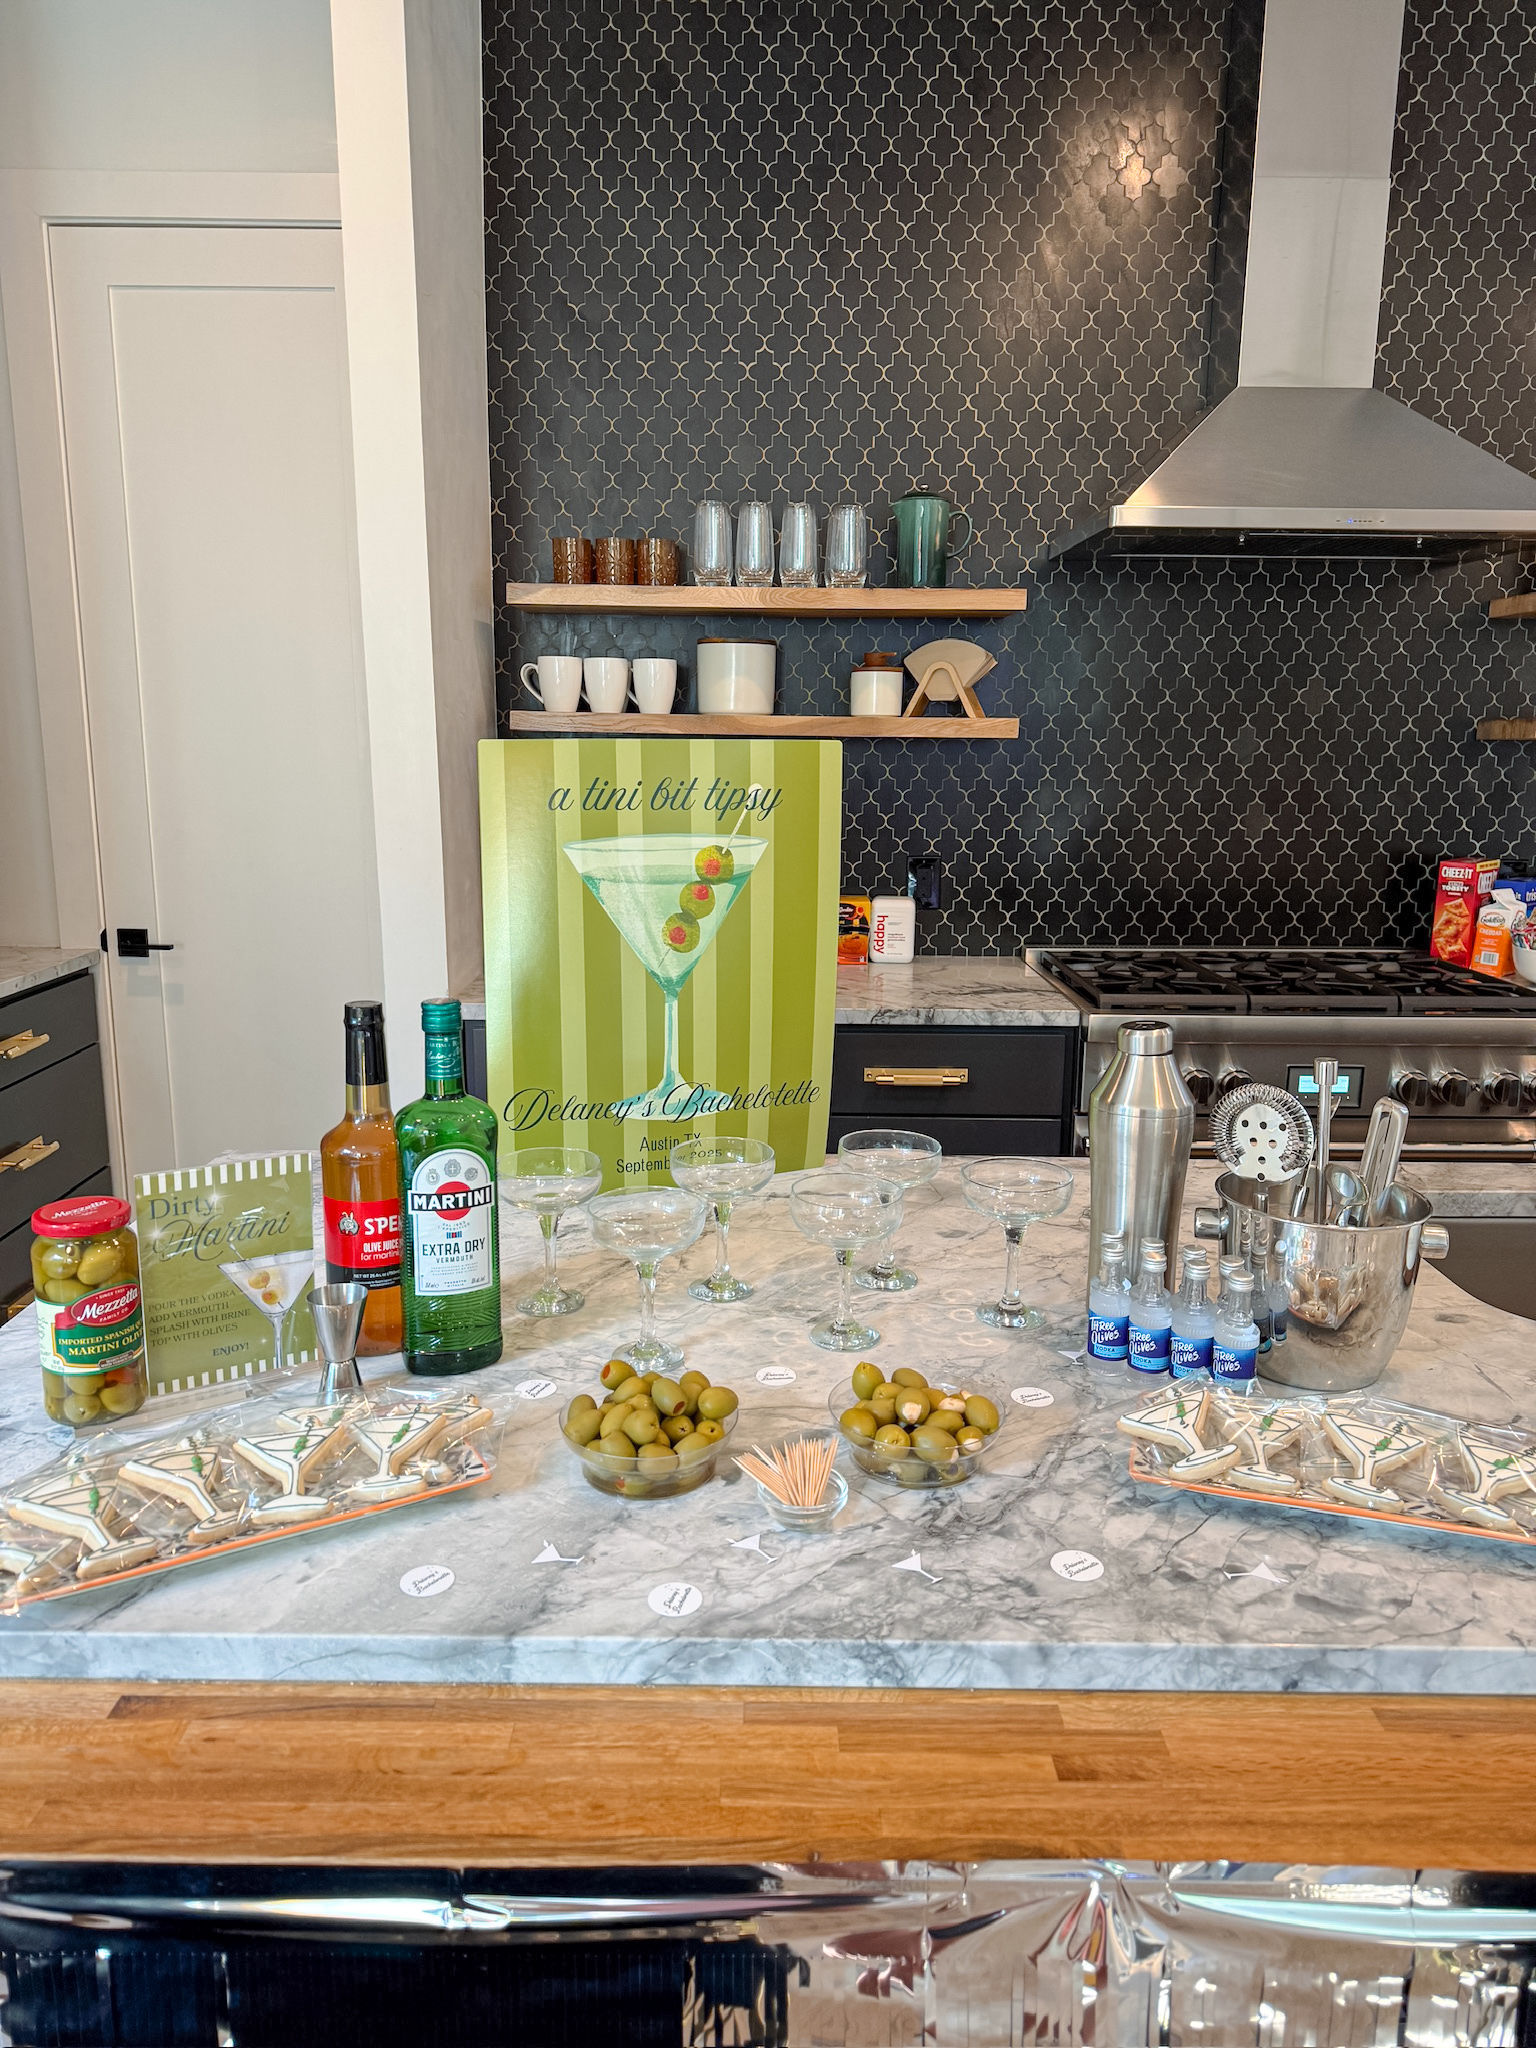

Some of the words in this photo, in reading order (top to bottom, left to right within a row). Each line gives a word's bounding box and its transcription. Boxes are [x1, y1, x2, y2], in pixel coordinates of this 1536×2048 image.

[547, 787, 575, 811] a
[582, 776, 643, 811] tini
[649, 776, 699, 811] bit
[703, 776, 784, 822] tipsy
[873, 915, 889, 954] happy
[503, 1087, 655, 1132] Delaney's
[639, 1135, 680, 1152] Austin
[690, 1148, 722, 1159] 2025
[150, 1195, 217, 1220] Dirty
[413, 1186, 491, 1211] MARTINI
[153, 1211, 290, 1262] Martini
[363, 1241, 382, 1253] OLIVE
[383, 1238, 399, 1251] JUICE
[422, 1242, 460, 1256] EXTRA
[465, 1237, 486, 1253] DRY
[436, 1254, 473, 1263] VERMOUTH
[77, 1287, 138, 1321] Mezzetta
[180, 1296, 199, 1306] THE
[202, 1289, 236, 1302] VODKA
[149, 1313, 170, 1325] ADD
[172, 1301, 229, 1321] VERMOUTH
[149, 1320, 189, 1336] SPLASH
[192, 1315, 218, 1326] WITH
[173, 1331, 200, 1343] WITH
[202, 1322, 238, 1337] OLIVES
[58, 1335, 103, 1345] IMPORTED
[68, 1340, 119, 1355] MARTINI
[212, 1342, 249, 1357] ENJOY!
[1133, 1355, 1152, 1364] VODKA
